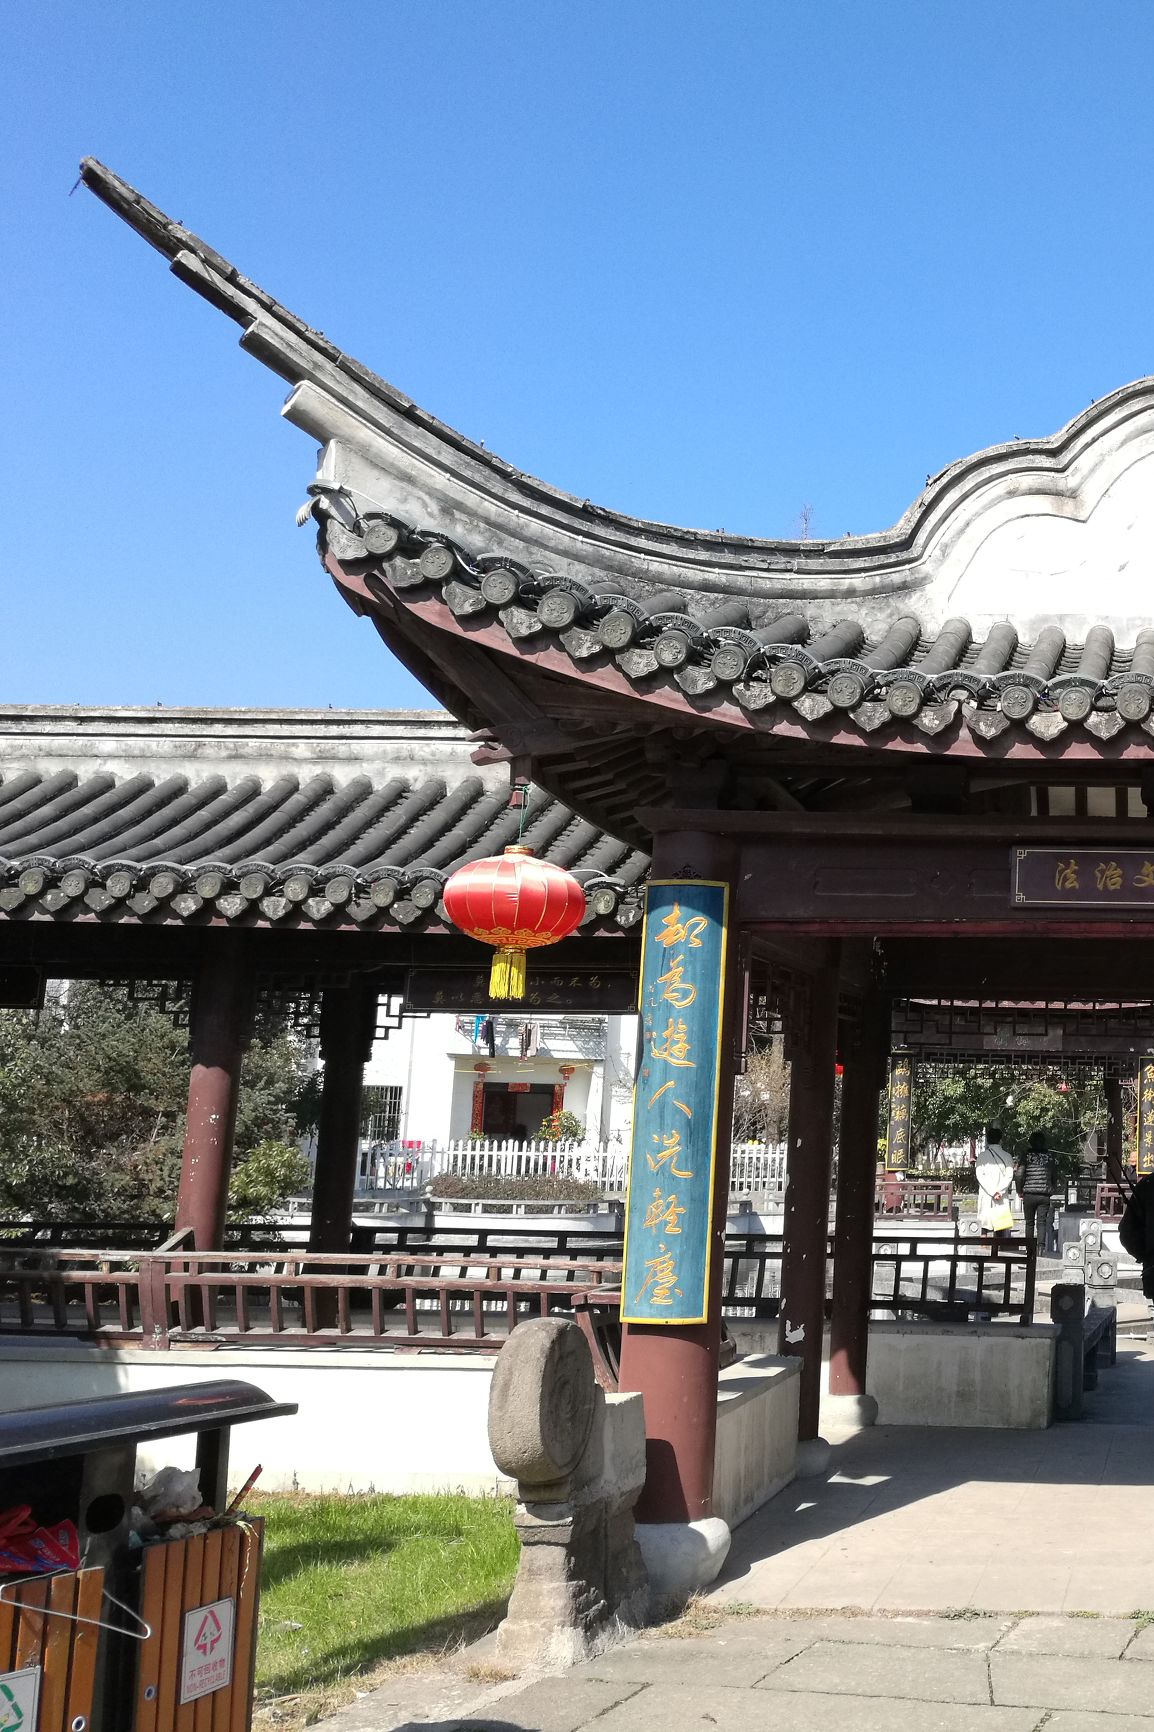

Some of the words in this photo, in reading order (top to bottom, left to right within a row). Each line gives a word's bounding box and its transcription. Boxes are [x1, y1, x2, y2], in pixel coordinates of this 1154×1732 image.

[189, 1658, 226, 1680] 不可回收物
